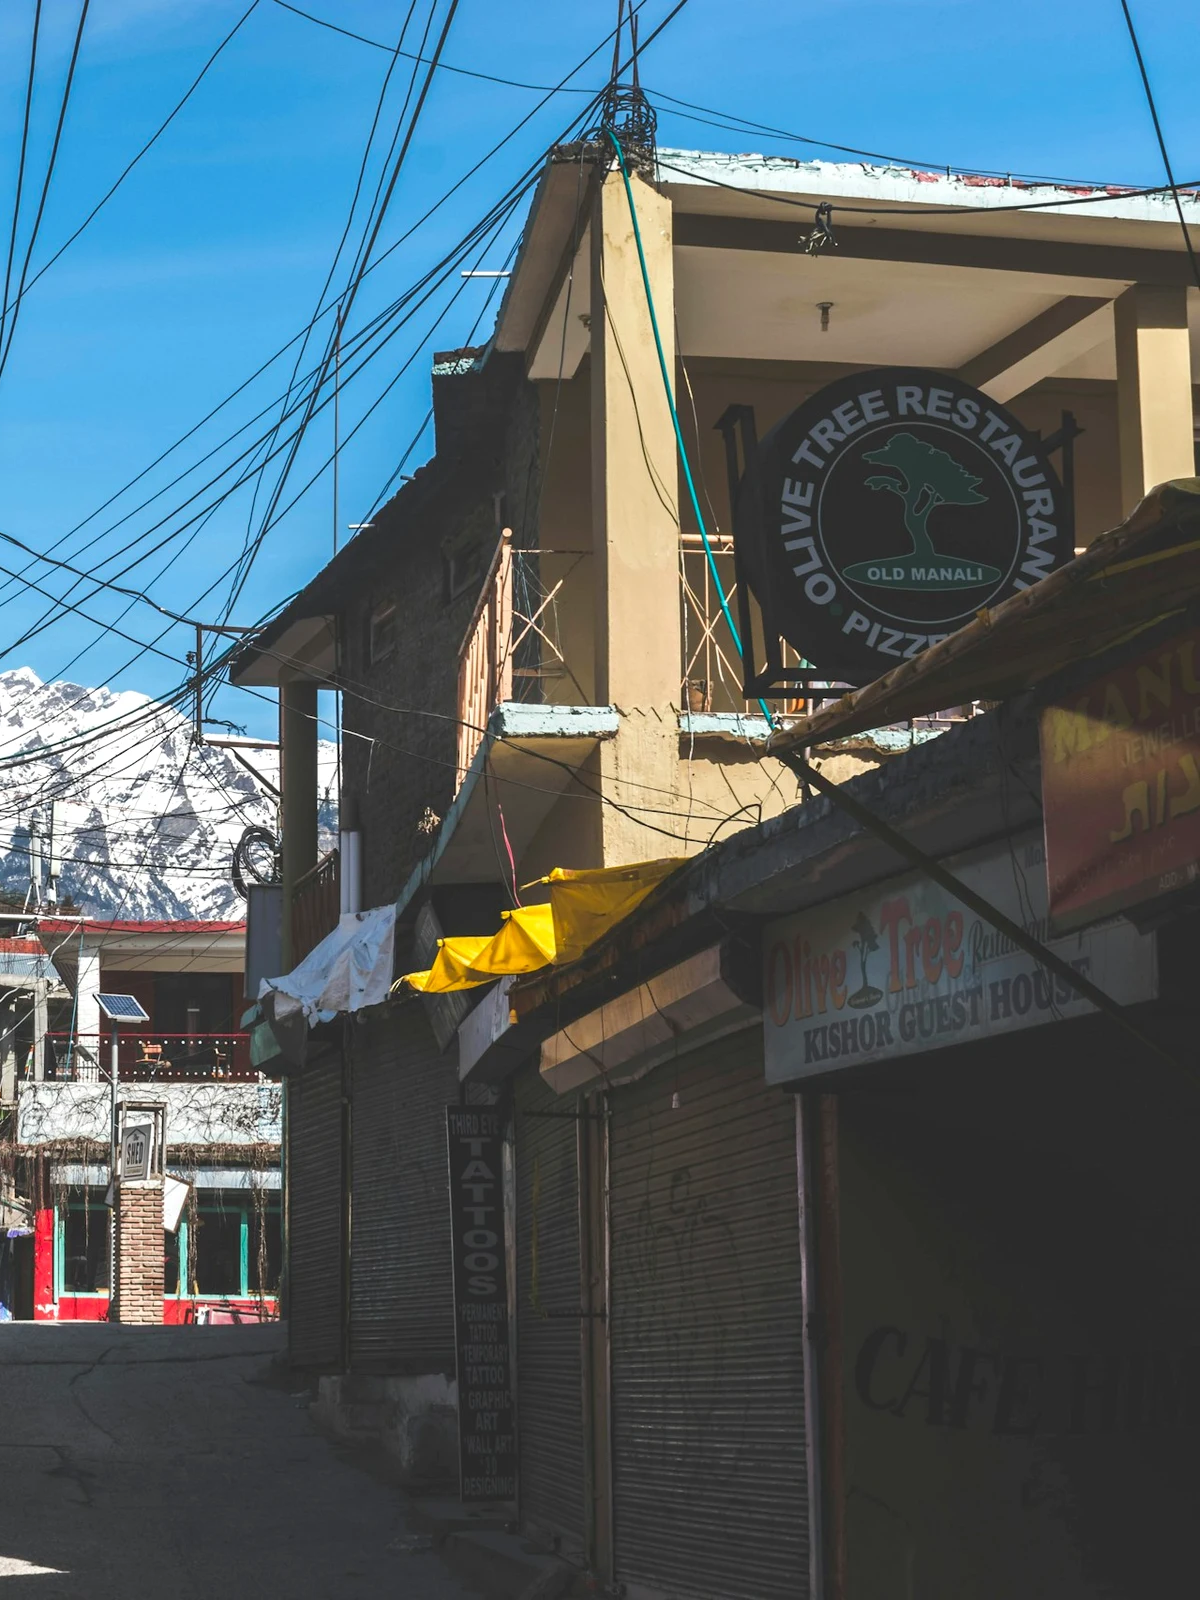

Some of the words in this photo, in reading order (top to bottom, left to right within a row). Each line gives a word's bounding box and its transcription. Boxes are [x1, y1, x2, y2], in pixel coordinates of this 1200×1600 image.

[791, 389, 891, 472] TREE
[781, 477, 837, 606] OLIVE
[896, 385, 1059, 593] RESTAURAN
[867, 567, 905, 581] OLD
[911, 567, 983, 581] MANALI
[767, 934, 848, 1027] Olive
[879, 896, 965, 993] Tree
[803, 1012, 894, 1064] KISHOR
[898, 987, 984, 1042] GUEST
[126, 1142, 144, 1166] SHED
[459, 1137, 500, 1297] TATTOOS
[855, 1326, 1046, 1436] CAFE
